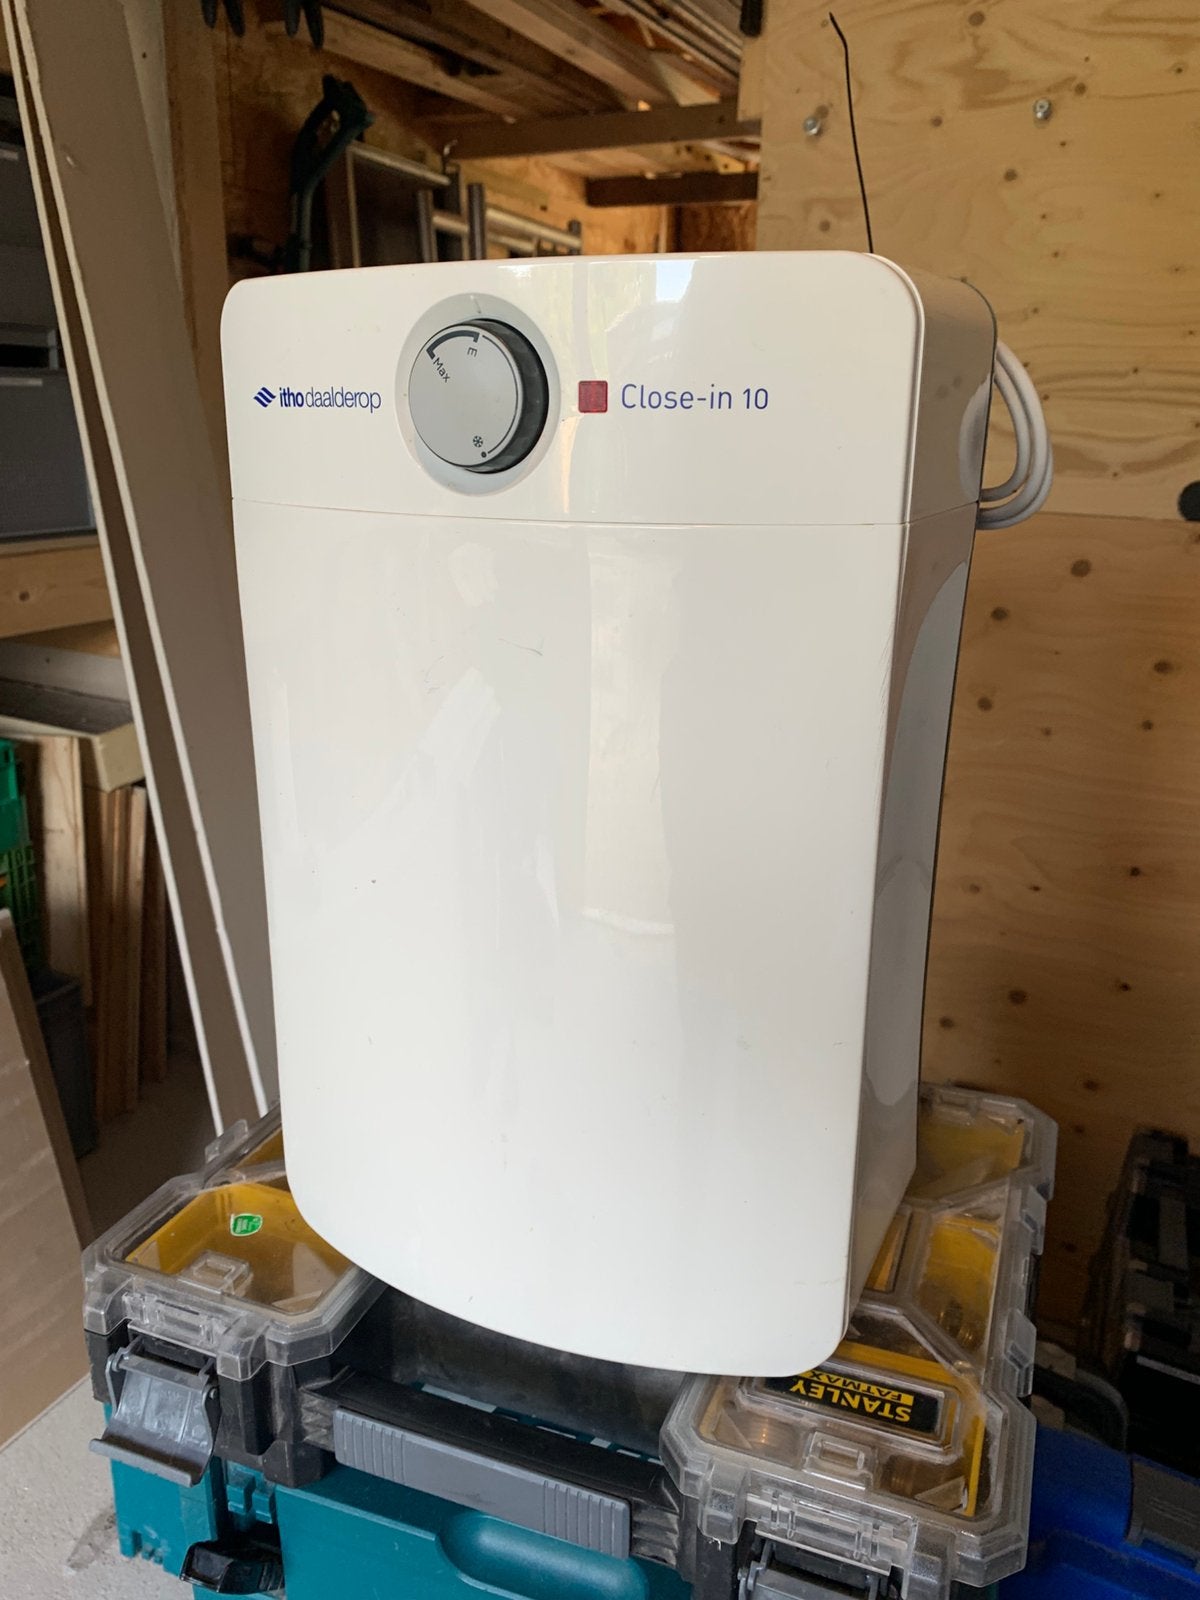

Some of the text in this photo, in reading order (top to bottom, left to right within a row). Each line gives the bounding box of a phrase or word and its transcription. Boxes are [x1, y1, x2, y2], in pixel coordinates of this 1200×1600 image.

[433, 357, 451, 383] Max
[621, 383, 769, 410] Close-in 10
[809, 1371, 903, 1401] FATMAX
[790, 1379, 912, 1422] STANLEY
